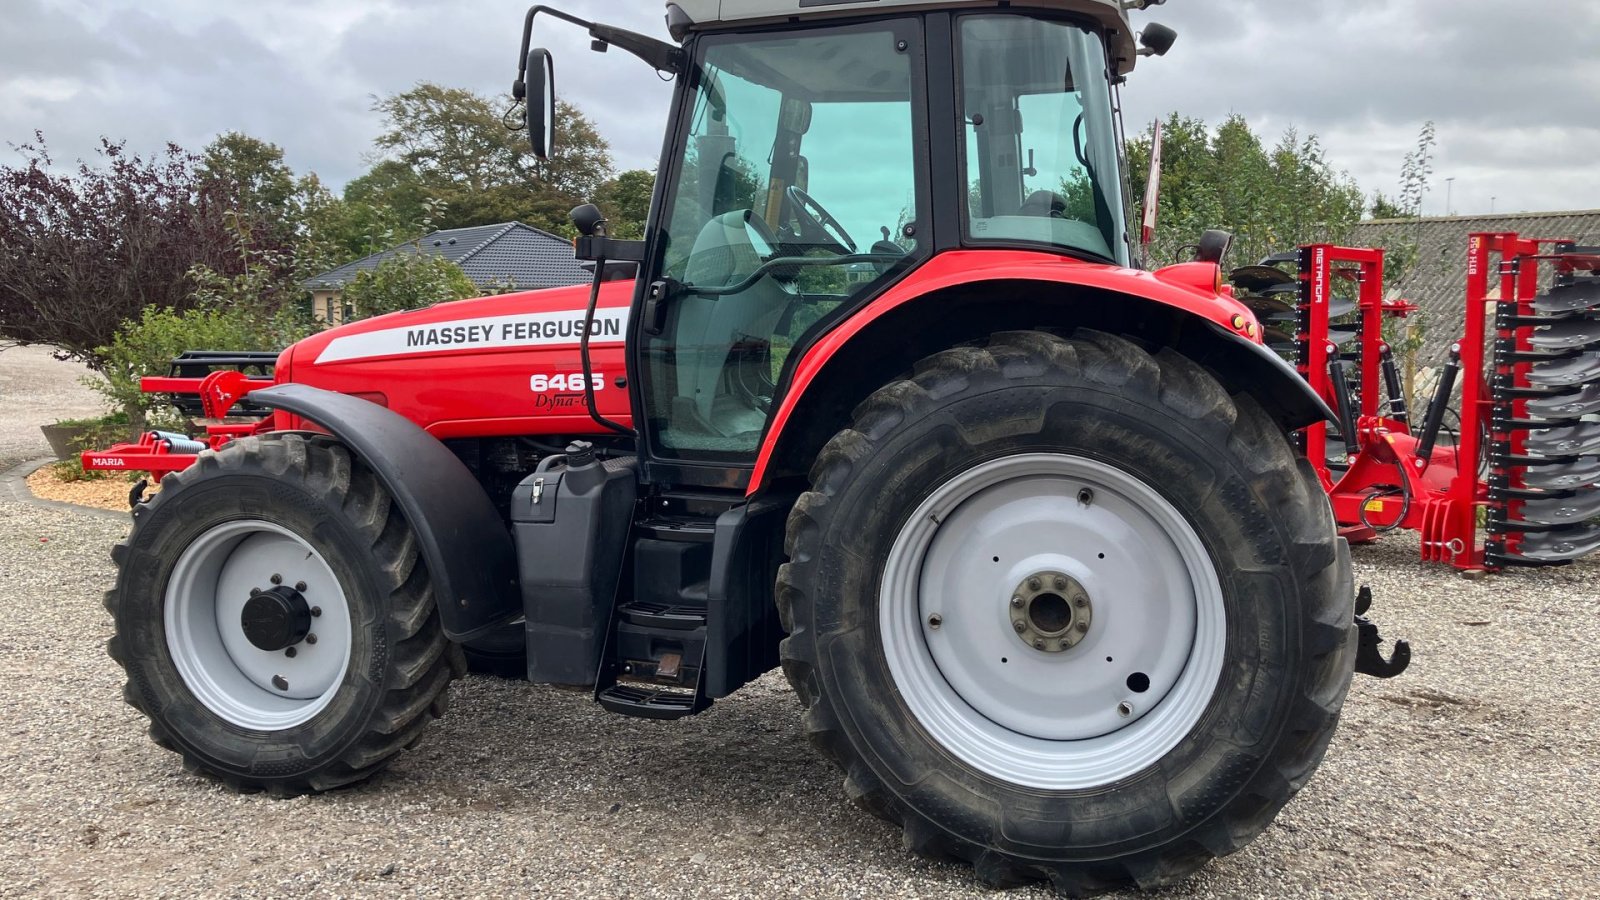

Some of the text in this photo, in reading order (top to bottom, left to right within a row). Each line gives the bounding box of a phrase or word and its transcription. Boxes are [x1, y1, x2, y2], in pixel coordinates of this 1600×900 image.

[1468, 236, 1478, 275] BTH 450
[406, 318, 620, 347] MASSEY FERGUSON
[530, 373, 605, 392] 6465
[92, 458, 125, 466] MARIA
